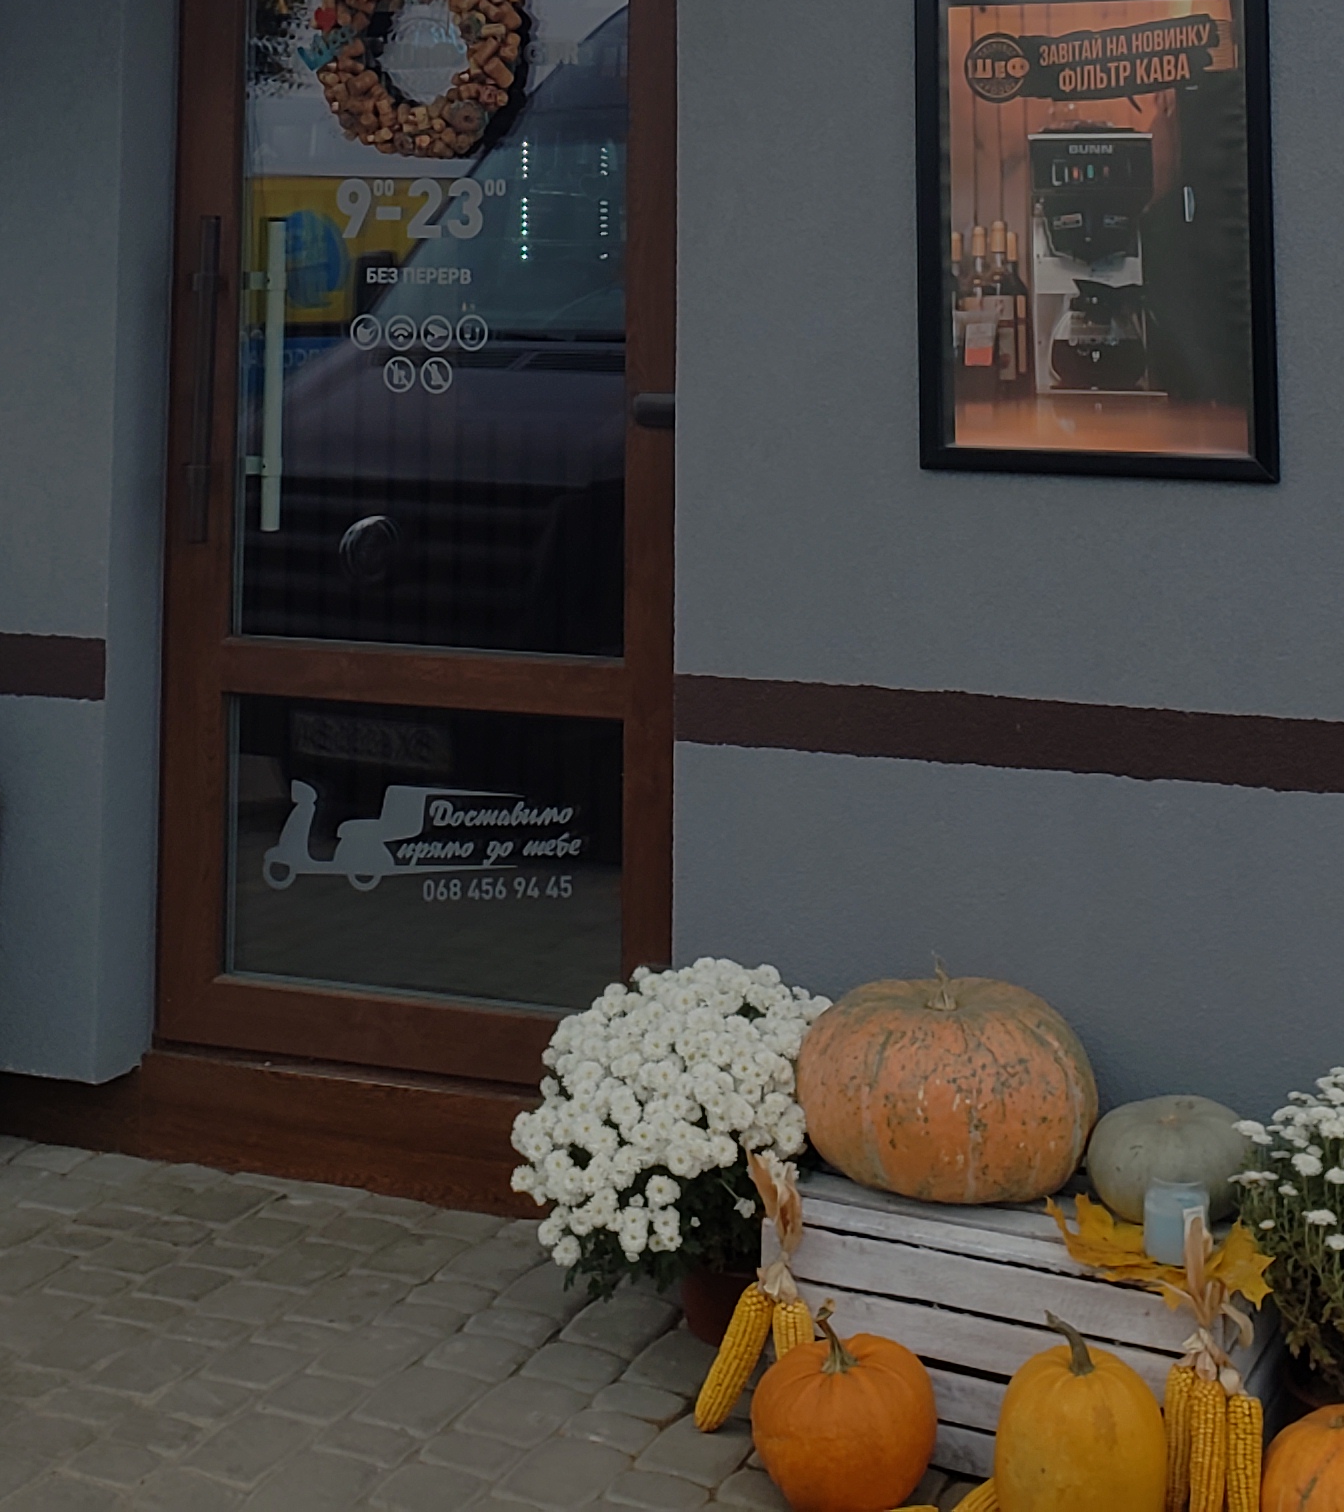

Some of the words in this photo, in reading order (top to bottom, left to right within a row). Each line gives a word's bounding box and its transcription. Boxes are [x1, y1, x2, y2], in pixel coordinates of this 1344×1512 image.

[1039, 34, 1103, 67] ЗАВІТАЙ
[1106, 35, 1128, 57] НА
[1131, 23, 1211, 55] НОВИНКУ
[1058, 60, 1131, 93] ФІЛЬТР
[1135, 52, 1191, 86] КАВА
[366, 267, 399, 284] БЕЗ
[402, 267, 472, 285] ПЕРЕРВ
[429, 799, 574, 827] Доставимо
[396, 839, 475, 867] прямо
[482, 840, 515, 869] до
[522, 832, 583, 858] тебе
[422, 878, 462, 902] 068
[467, 876, 507, 901] 456
[512, 876, 540, 899] 94
[545, 875, 573, 899] 45
